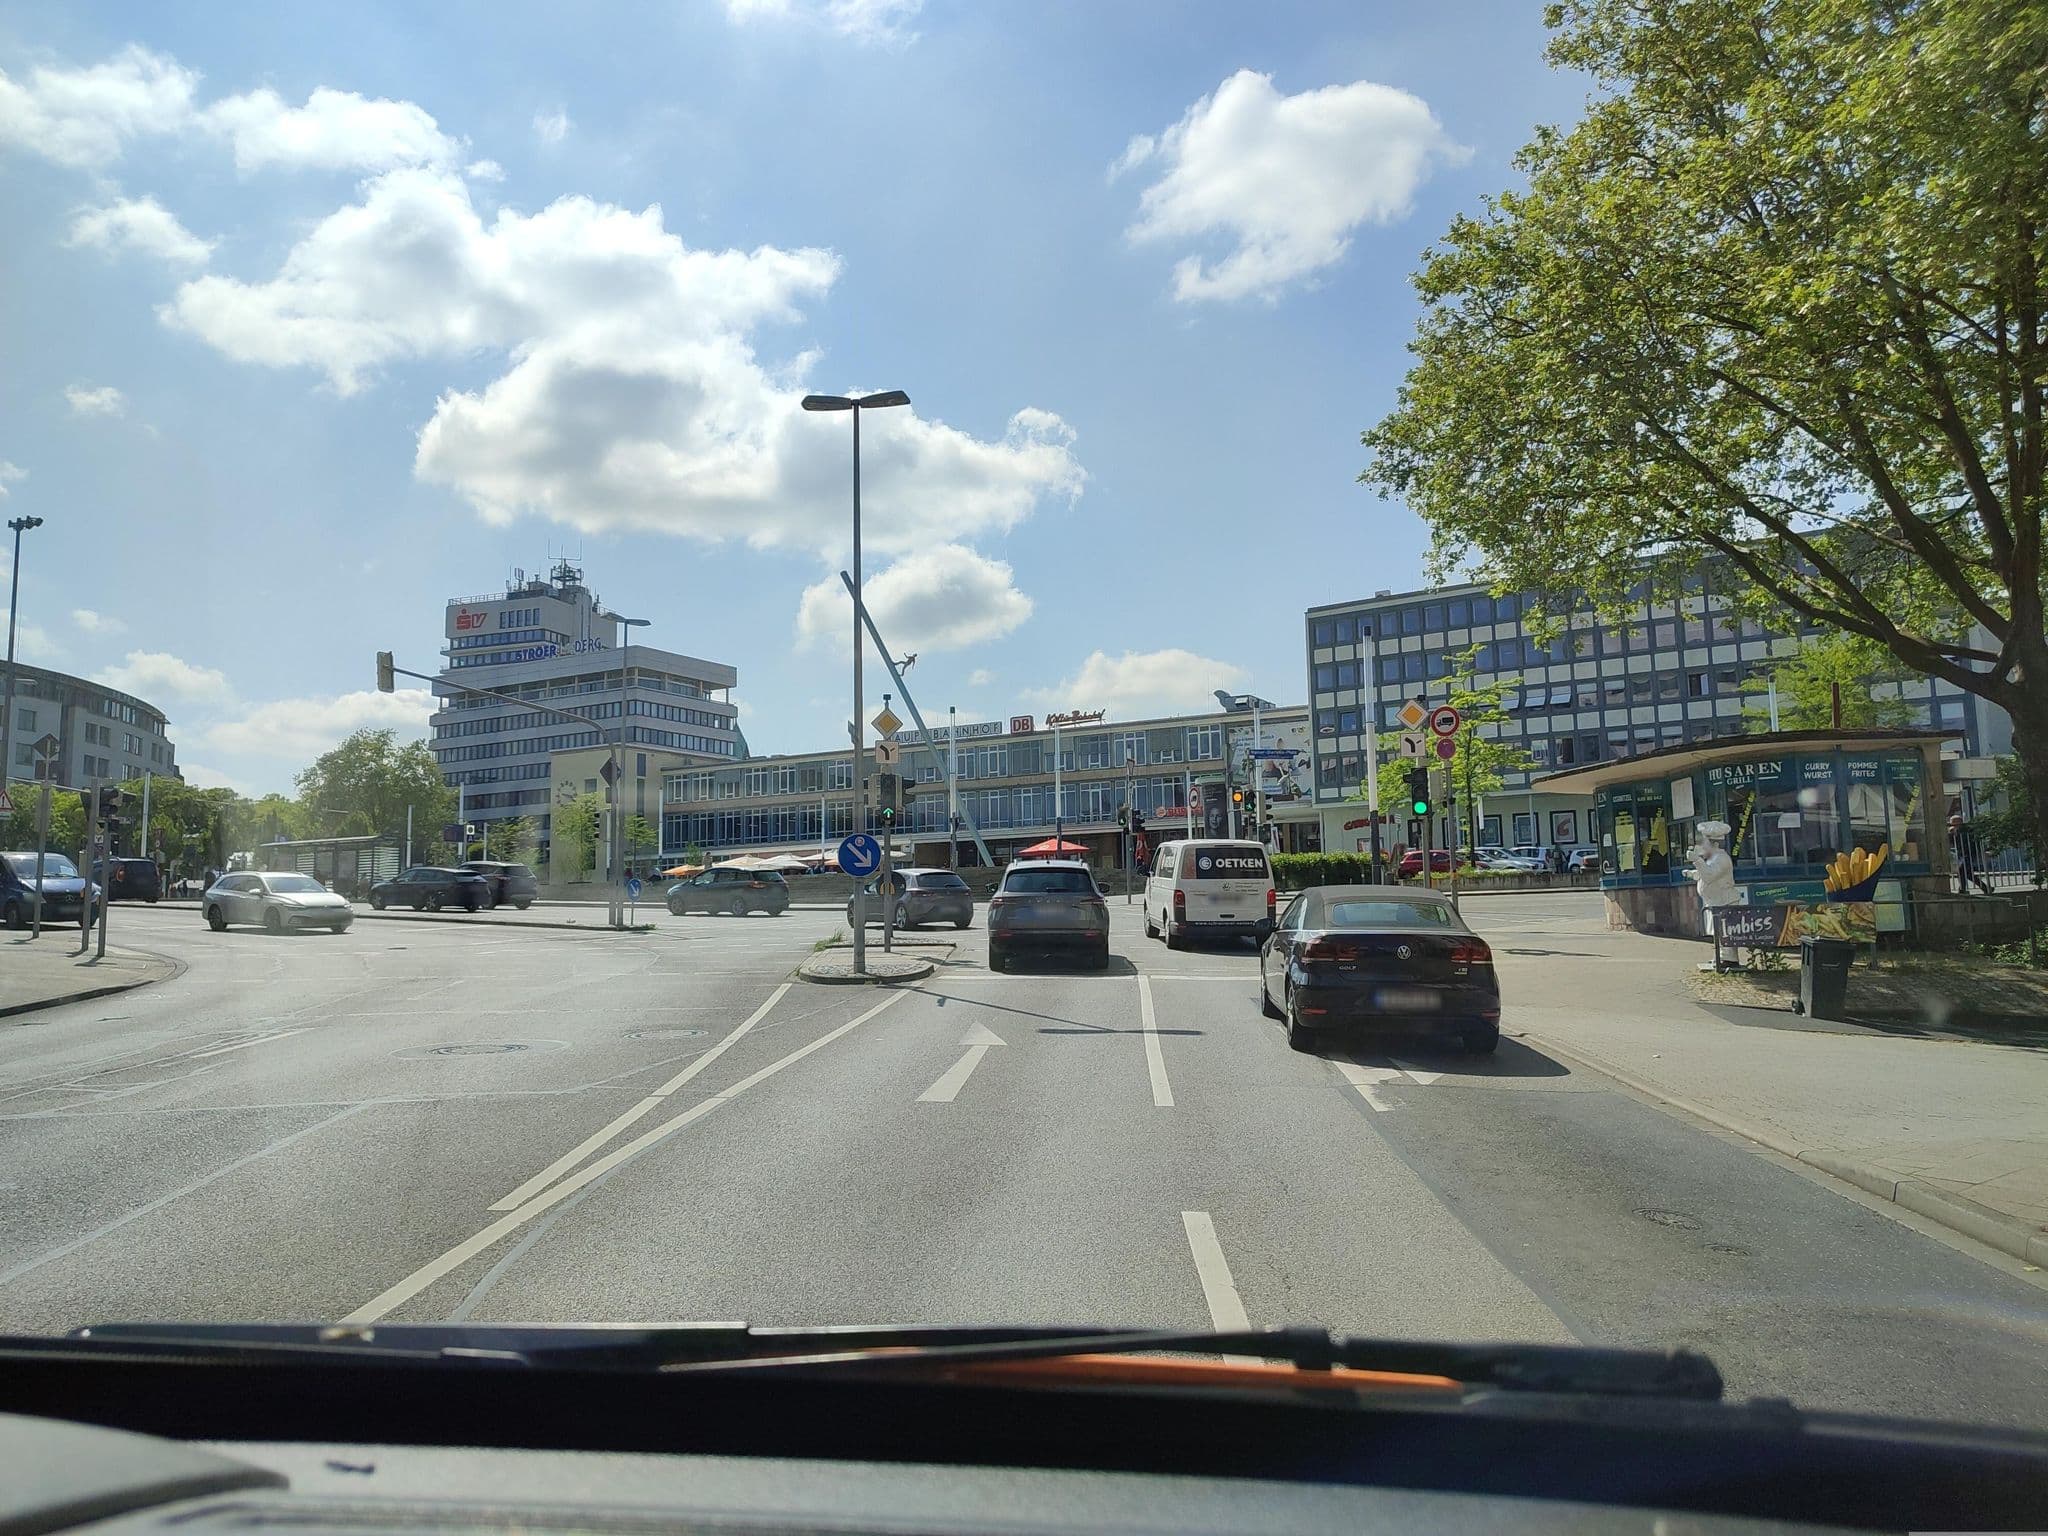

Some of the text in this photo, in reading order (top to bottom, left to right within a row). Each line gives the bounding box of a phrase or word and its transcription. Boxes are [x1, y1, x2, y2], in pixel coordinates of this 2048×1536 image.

[1013, 718, 1031, 732] DB
[1804, 762, 1830, 770] CURRY
[1847, 761, 1878, 770] POMMES
[1708, 761, 1783, 781] HUSAREN
[1803, 770, 1833, 779] WURST
[1851, 770, 1876, 778] FRITES
[1726, 776, 1753, 786] GRILL
[1215, 858, 1264, 868] OETKEN
[1720, 915, 1773, 938] Imbiss
